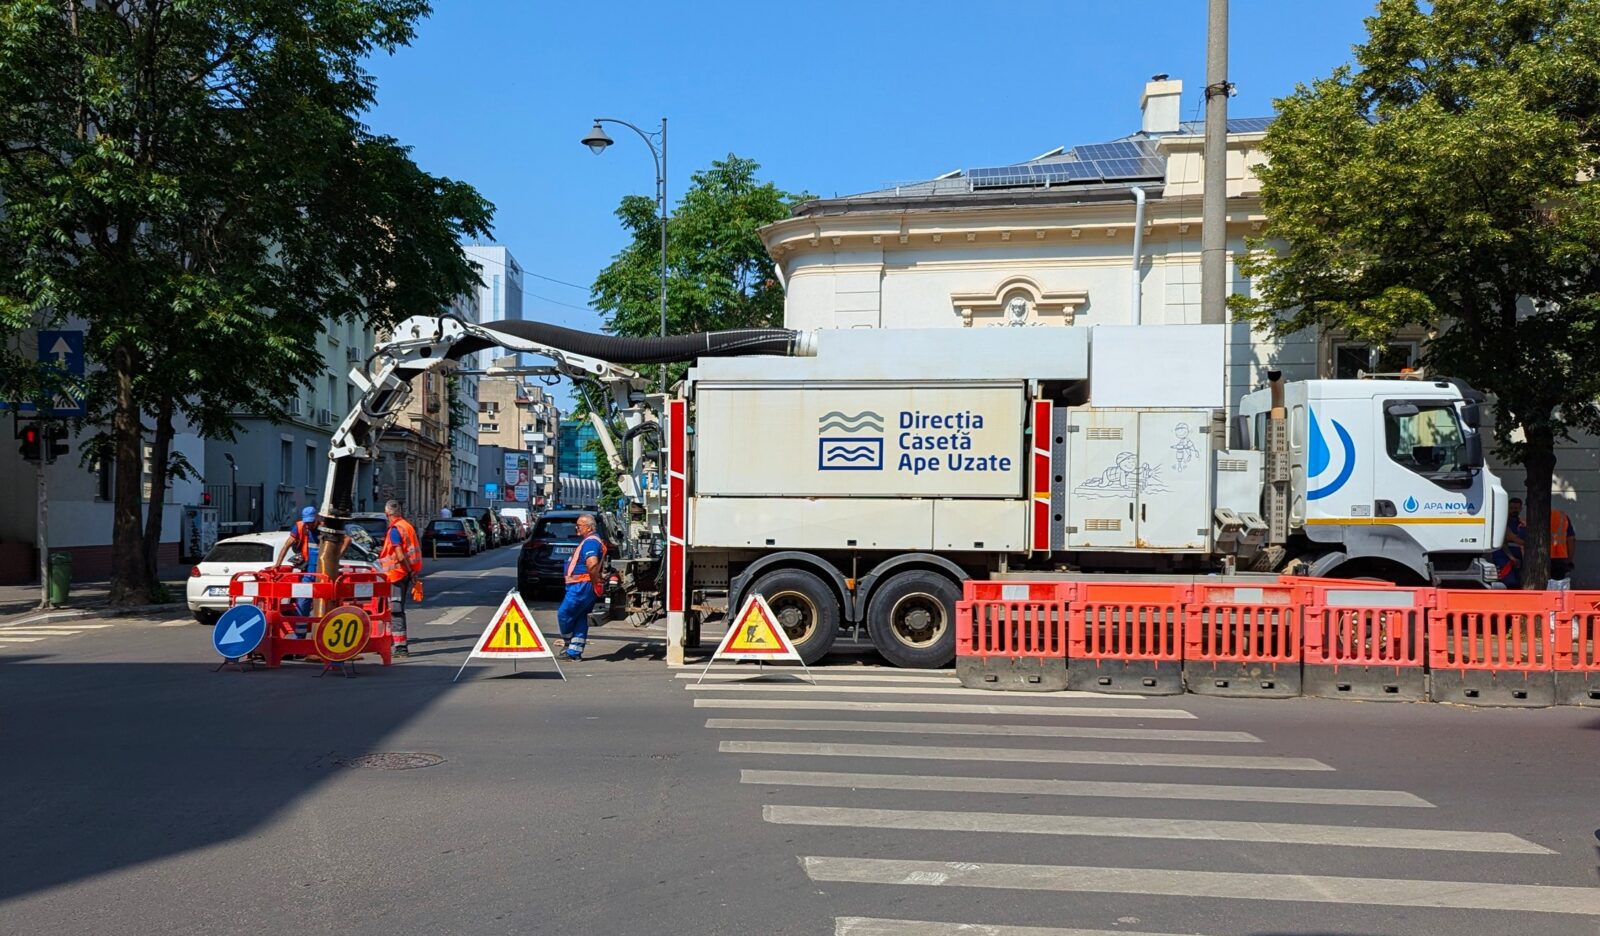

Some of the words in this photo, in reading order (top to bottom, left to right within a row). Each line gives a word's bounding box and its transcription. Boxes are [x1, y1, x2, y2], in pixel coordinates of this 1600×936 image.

[899, 410, 984, 433] Direcția
[899, 432, 972, 450] Casetă
[898, 453, 940, 475] Ape
[948, 453, 1012, 471] Uzate
[1424, 502, 1443, 510] APA
[1445, 502, 1475, 510] NOVA
[328, 618, 359, 647] 30
